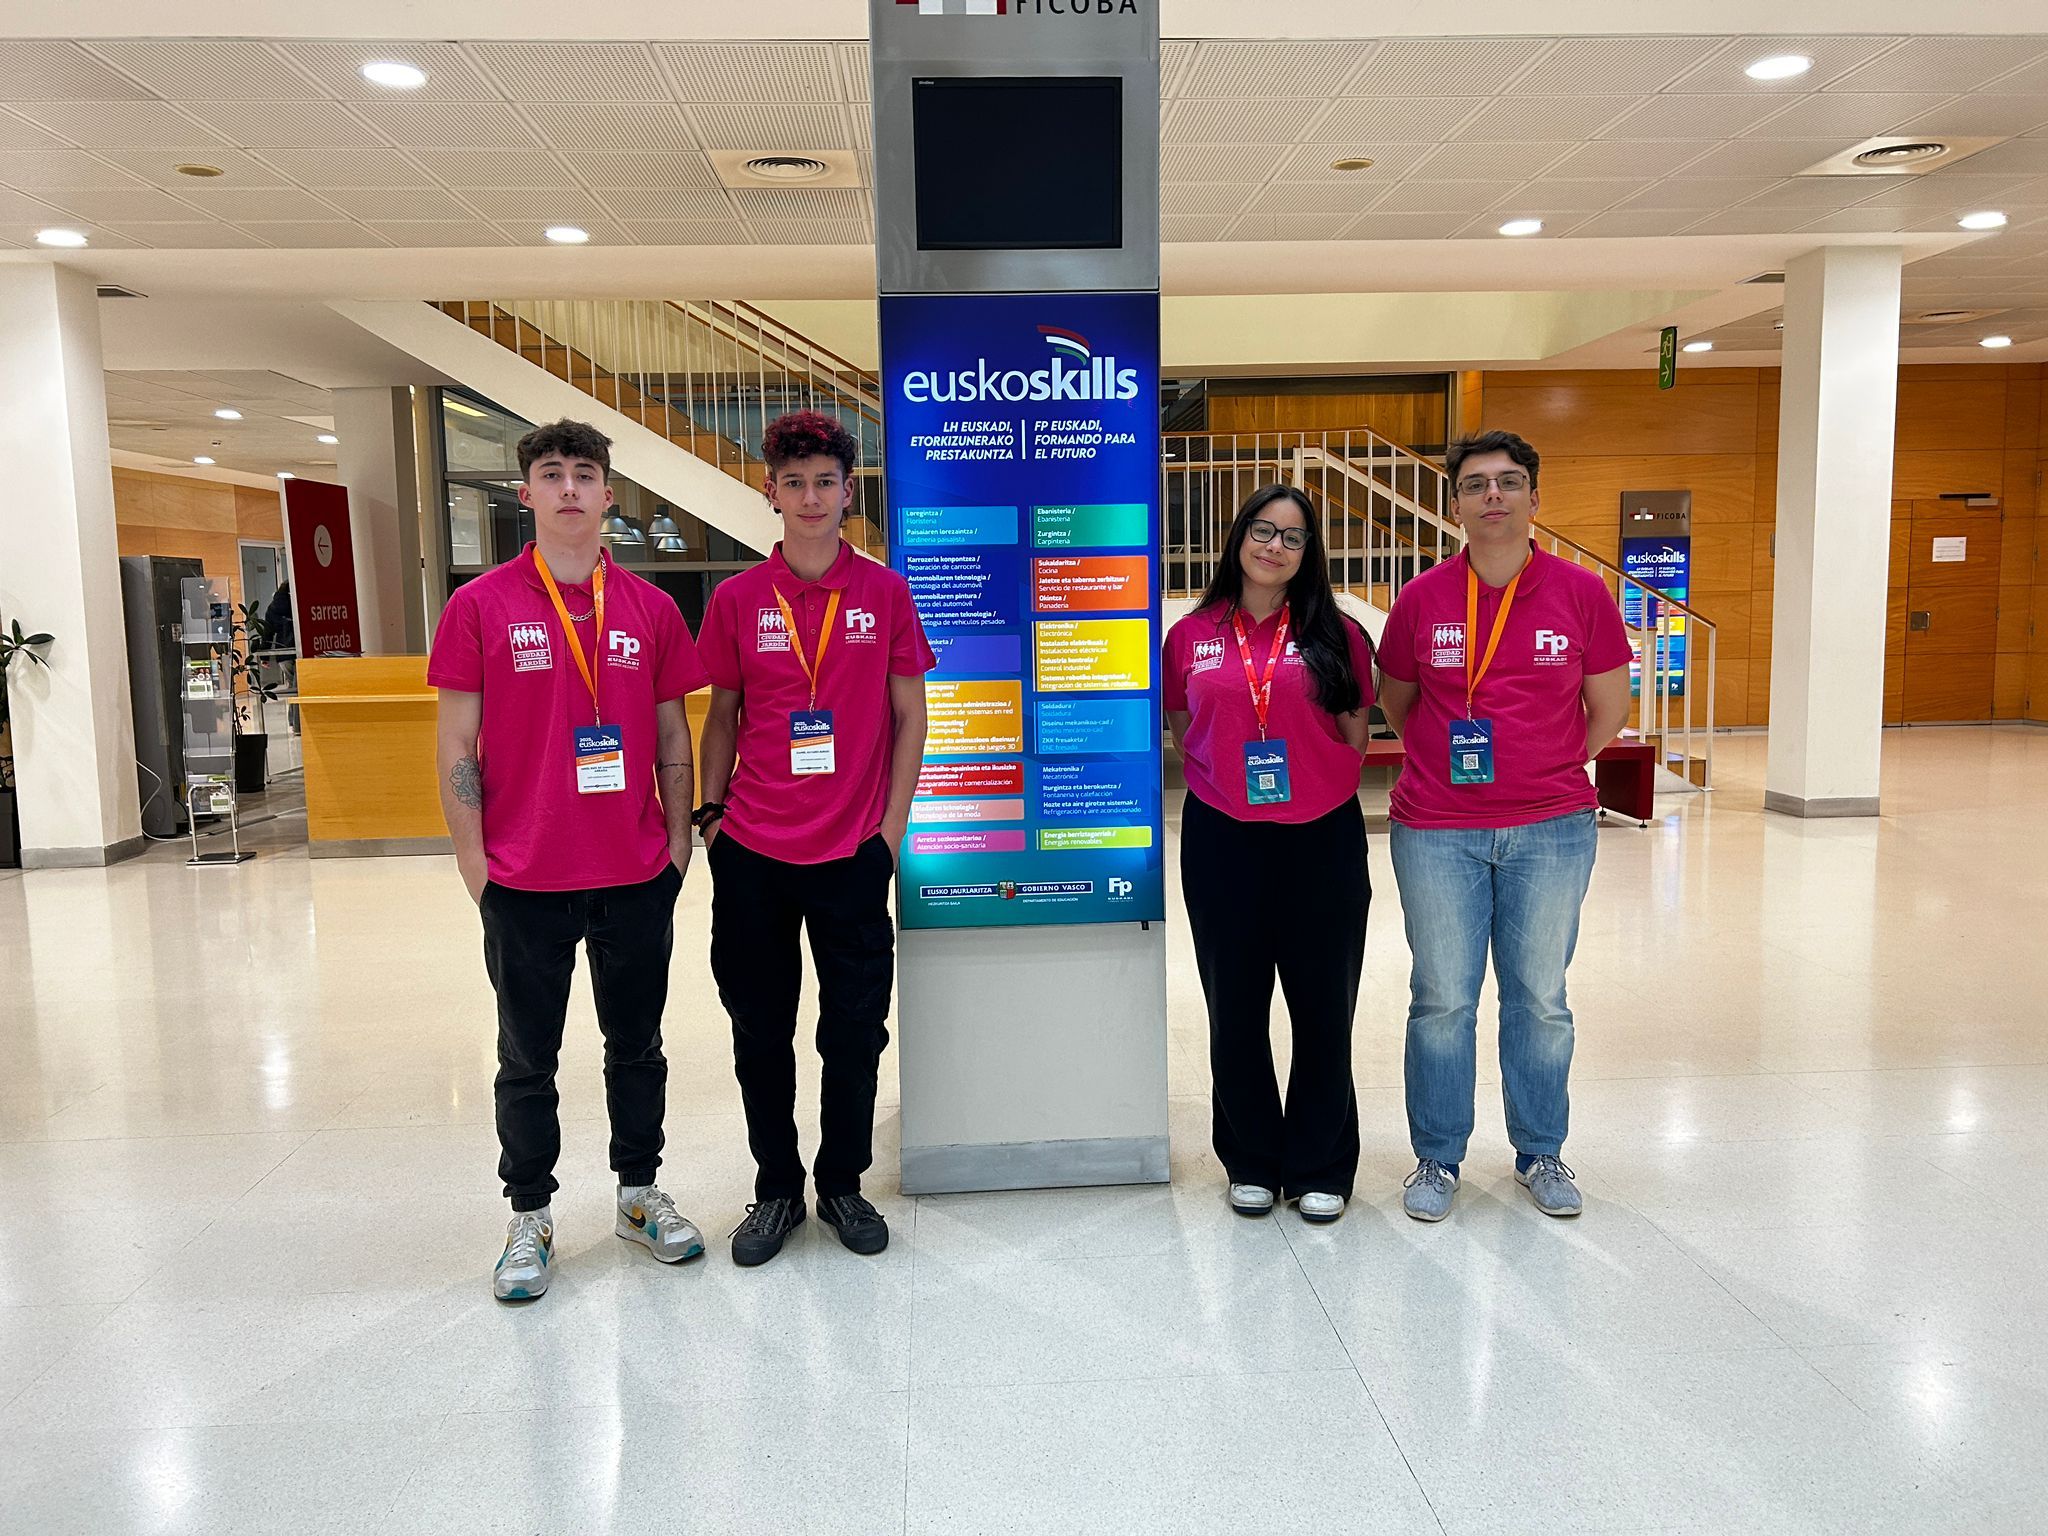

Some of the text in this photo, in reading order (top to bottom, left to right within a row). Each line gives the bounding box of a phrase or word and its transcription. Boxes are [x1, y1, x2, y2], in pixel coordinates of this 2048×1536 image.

[903, 356, 1139, 402] euskoskills
[943, 421, 1013, 434] LH EUSKADI,
[1034, 419, 1102, 432] FP EUSKADI,
[910, 435, 1014, 447] ETORKIZUNERAKO
[1034, 433, 1136, 445] FORMANDO PARA
[926, 449, 1014, 461] PRESTAKUNTZA
[1034, 448, 1096, 459] EL FUTURO
[1627, 551, 1685, 564] euskoskills
[310, 604, 348, 621] sarrera
[846, 608, 876, 632] Fp
[980, 618, 1005, 626] pesados
[313, 630, 350, 651] entrada
[608, 630, 640, 657] Fp
[1535, 630, 1568, 655] Fp
[517, 651, 546, 659] CIUDAD
[607, 657, 640, 666] EUSKADI
[579, 739, 618, 748] euskoskills
[950, 887, 992, 895] JAURLARITZA
[1108, 877, 1132, 896] Fp
